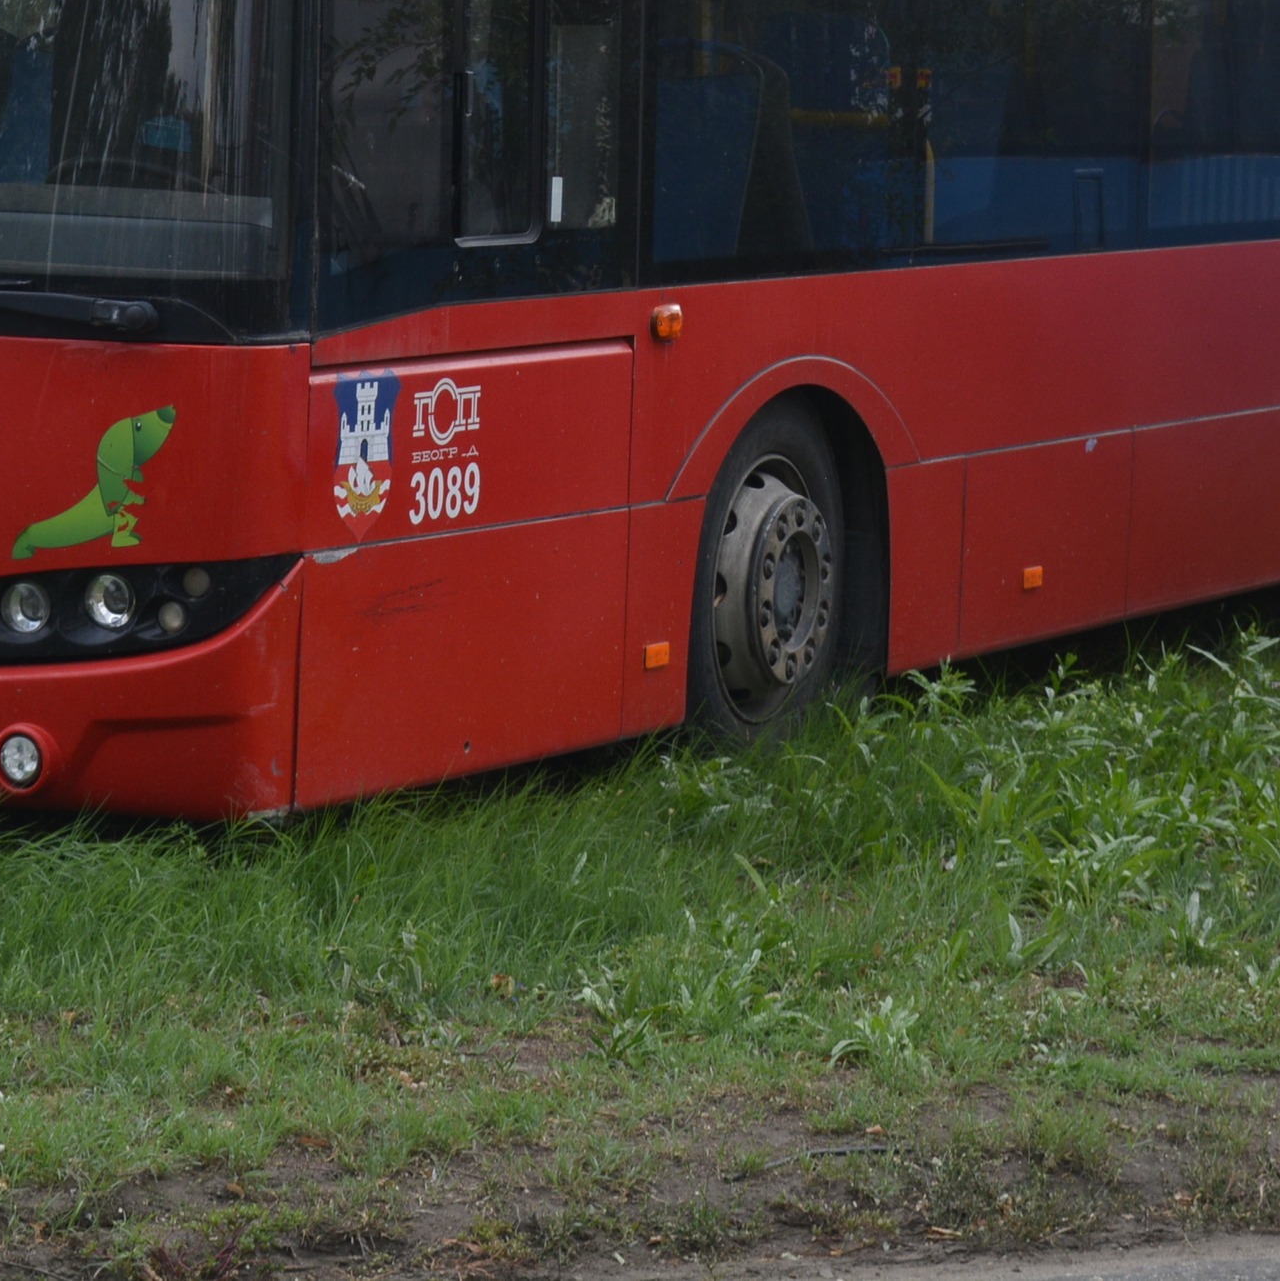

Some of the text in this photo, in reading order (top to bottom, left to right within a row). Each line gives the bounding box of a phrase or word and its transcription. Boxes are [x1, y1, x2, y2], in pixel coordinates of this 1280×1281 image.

[412, 377, 481, 445] ГСП
[411, 444, 479, 464] БЕОГРД
[409, 462, 480, 525] 3089
